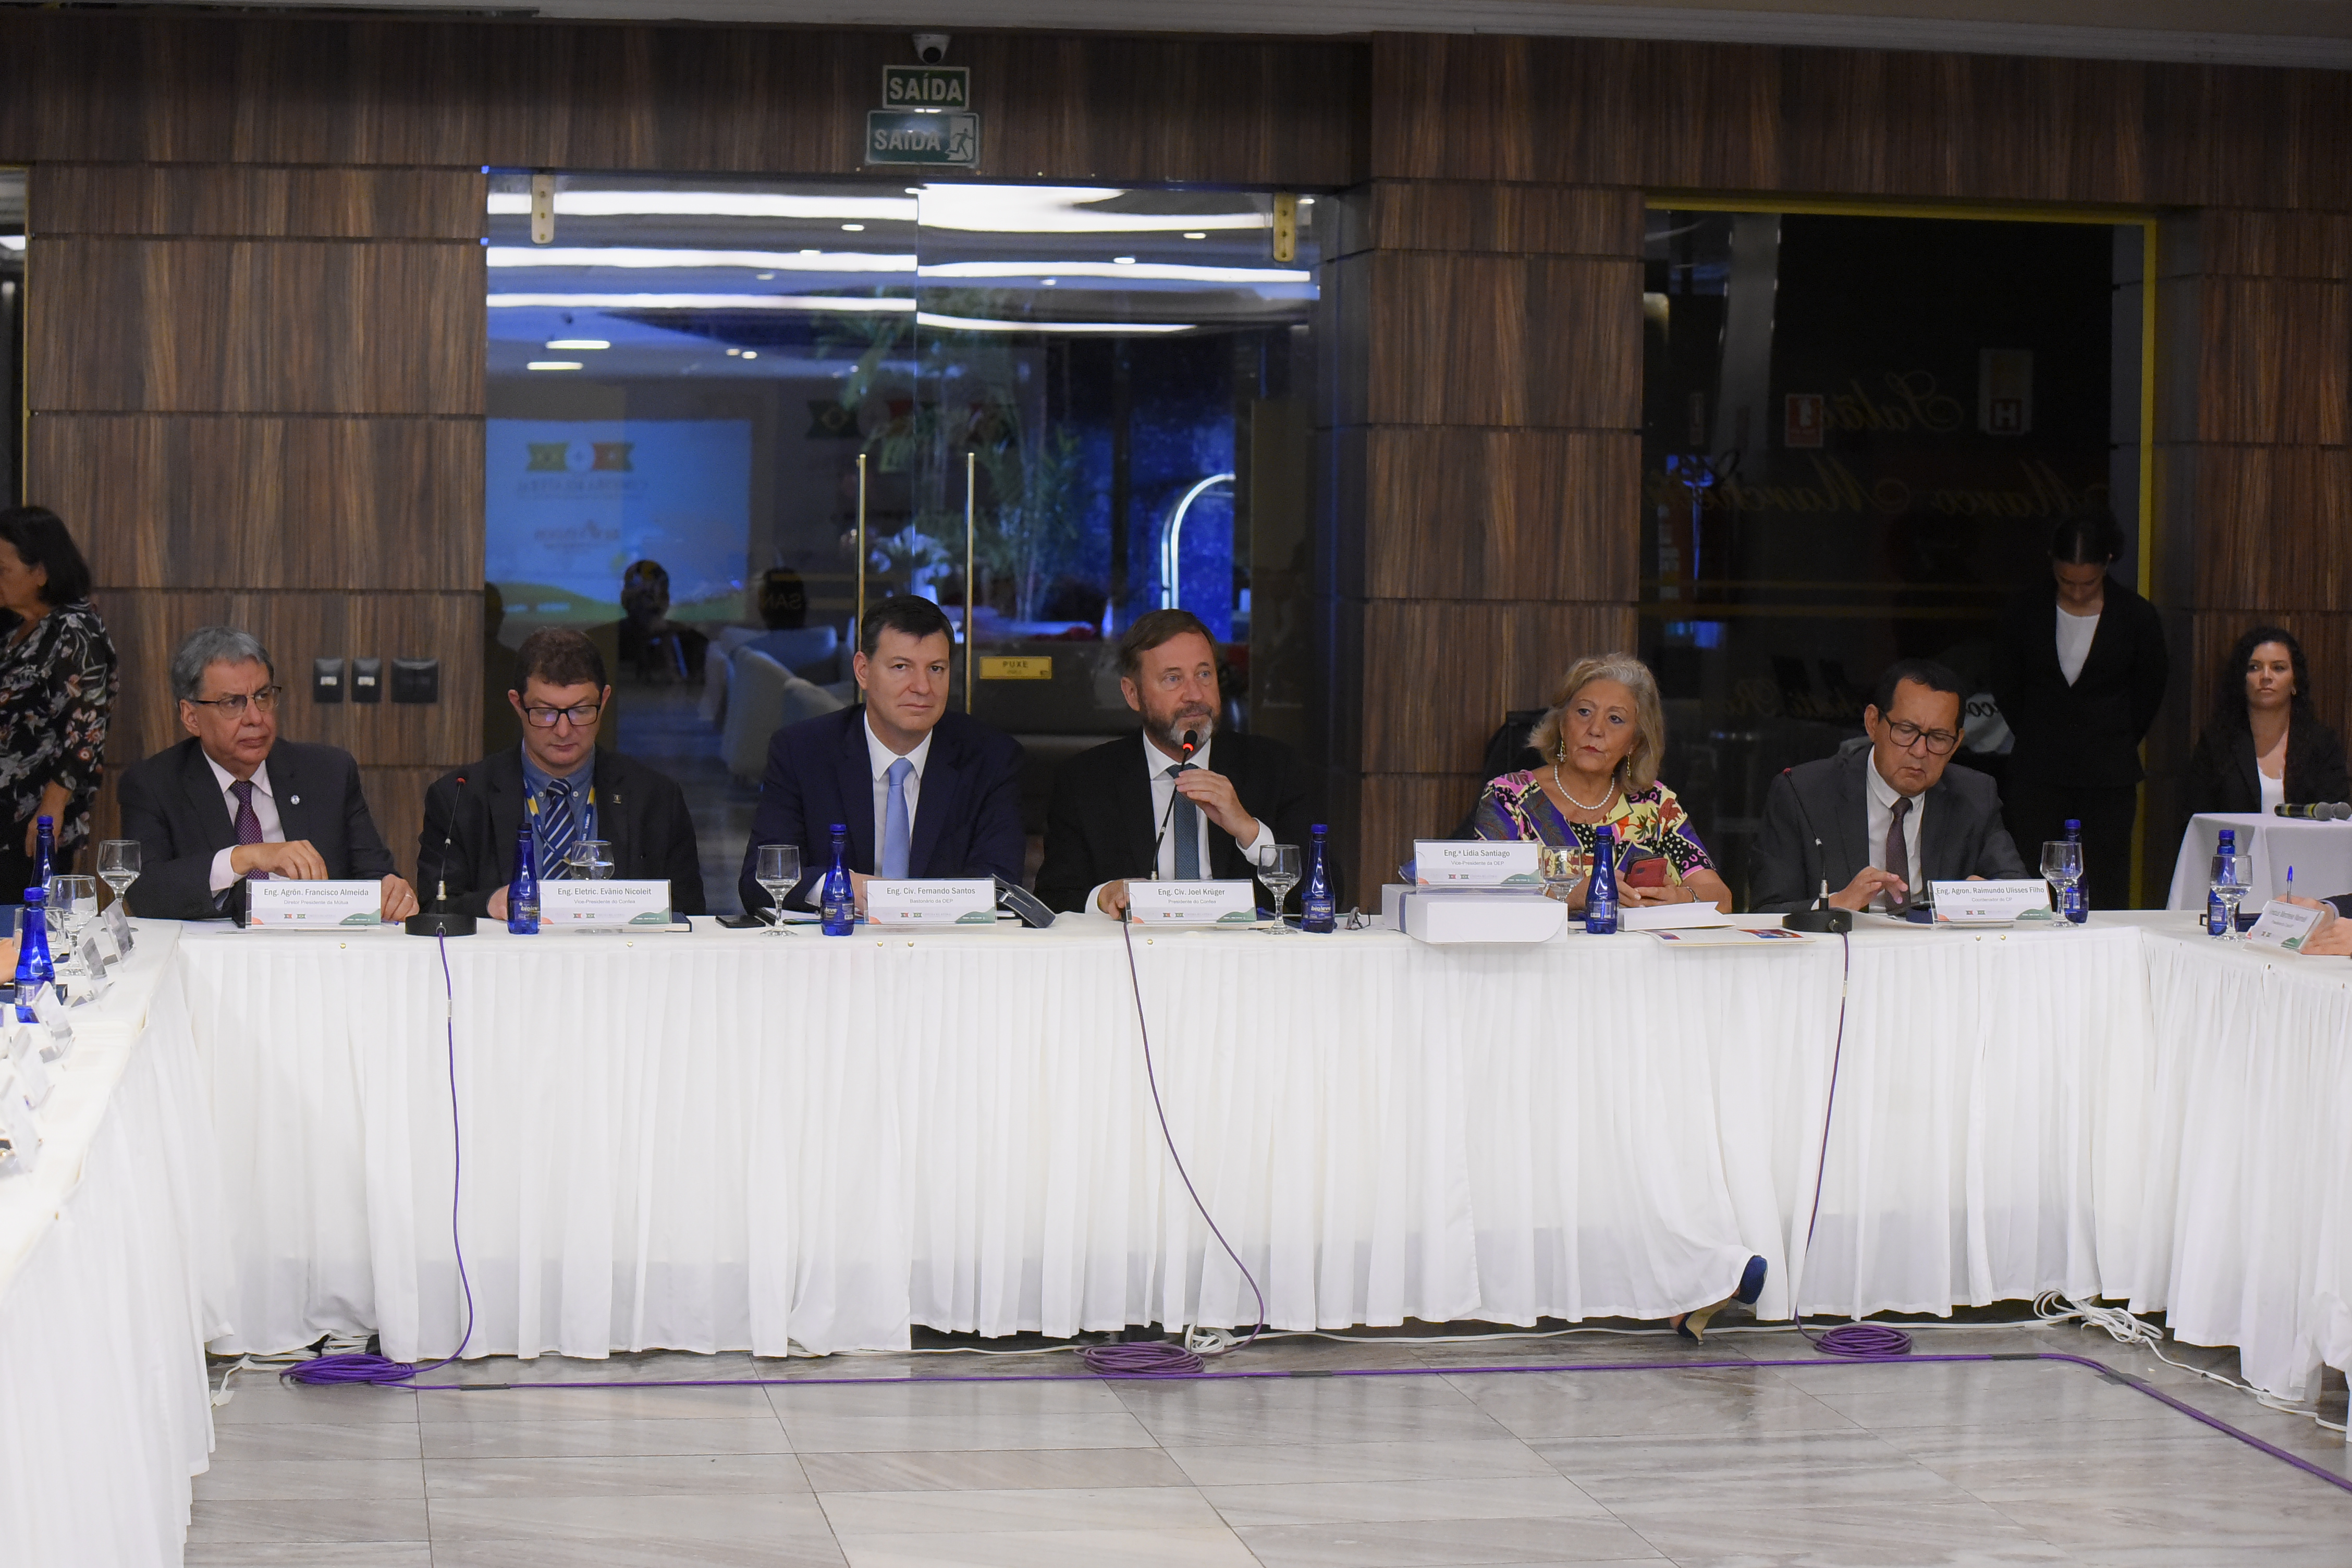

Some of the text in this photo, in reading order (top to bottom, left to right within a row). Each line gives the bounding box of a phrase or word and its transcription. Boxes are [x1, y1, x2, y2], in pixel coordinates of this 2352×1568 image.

[889, 73, 962, 101] SAÍDA
[1480, 849, 1510, 858] Santiago
[264, 888, 279, 897] Eng.
[281, 888, 303, 897] Agrôn.
[558, 888, 572, 896] Eng.
[887, 887, 901, 896] Eng.
[1158, 888, 1172, 897] Eng.
[1203, 888, 1225, 897] Krüger
